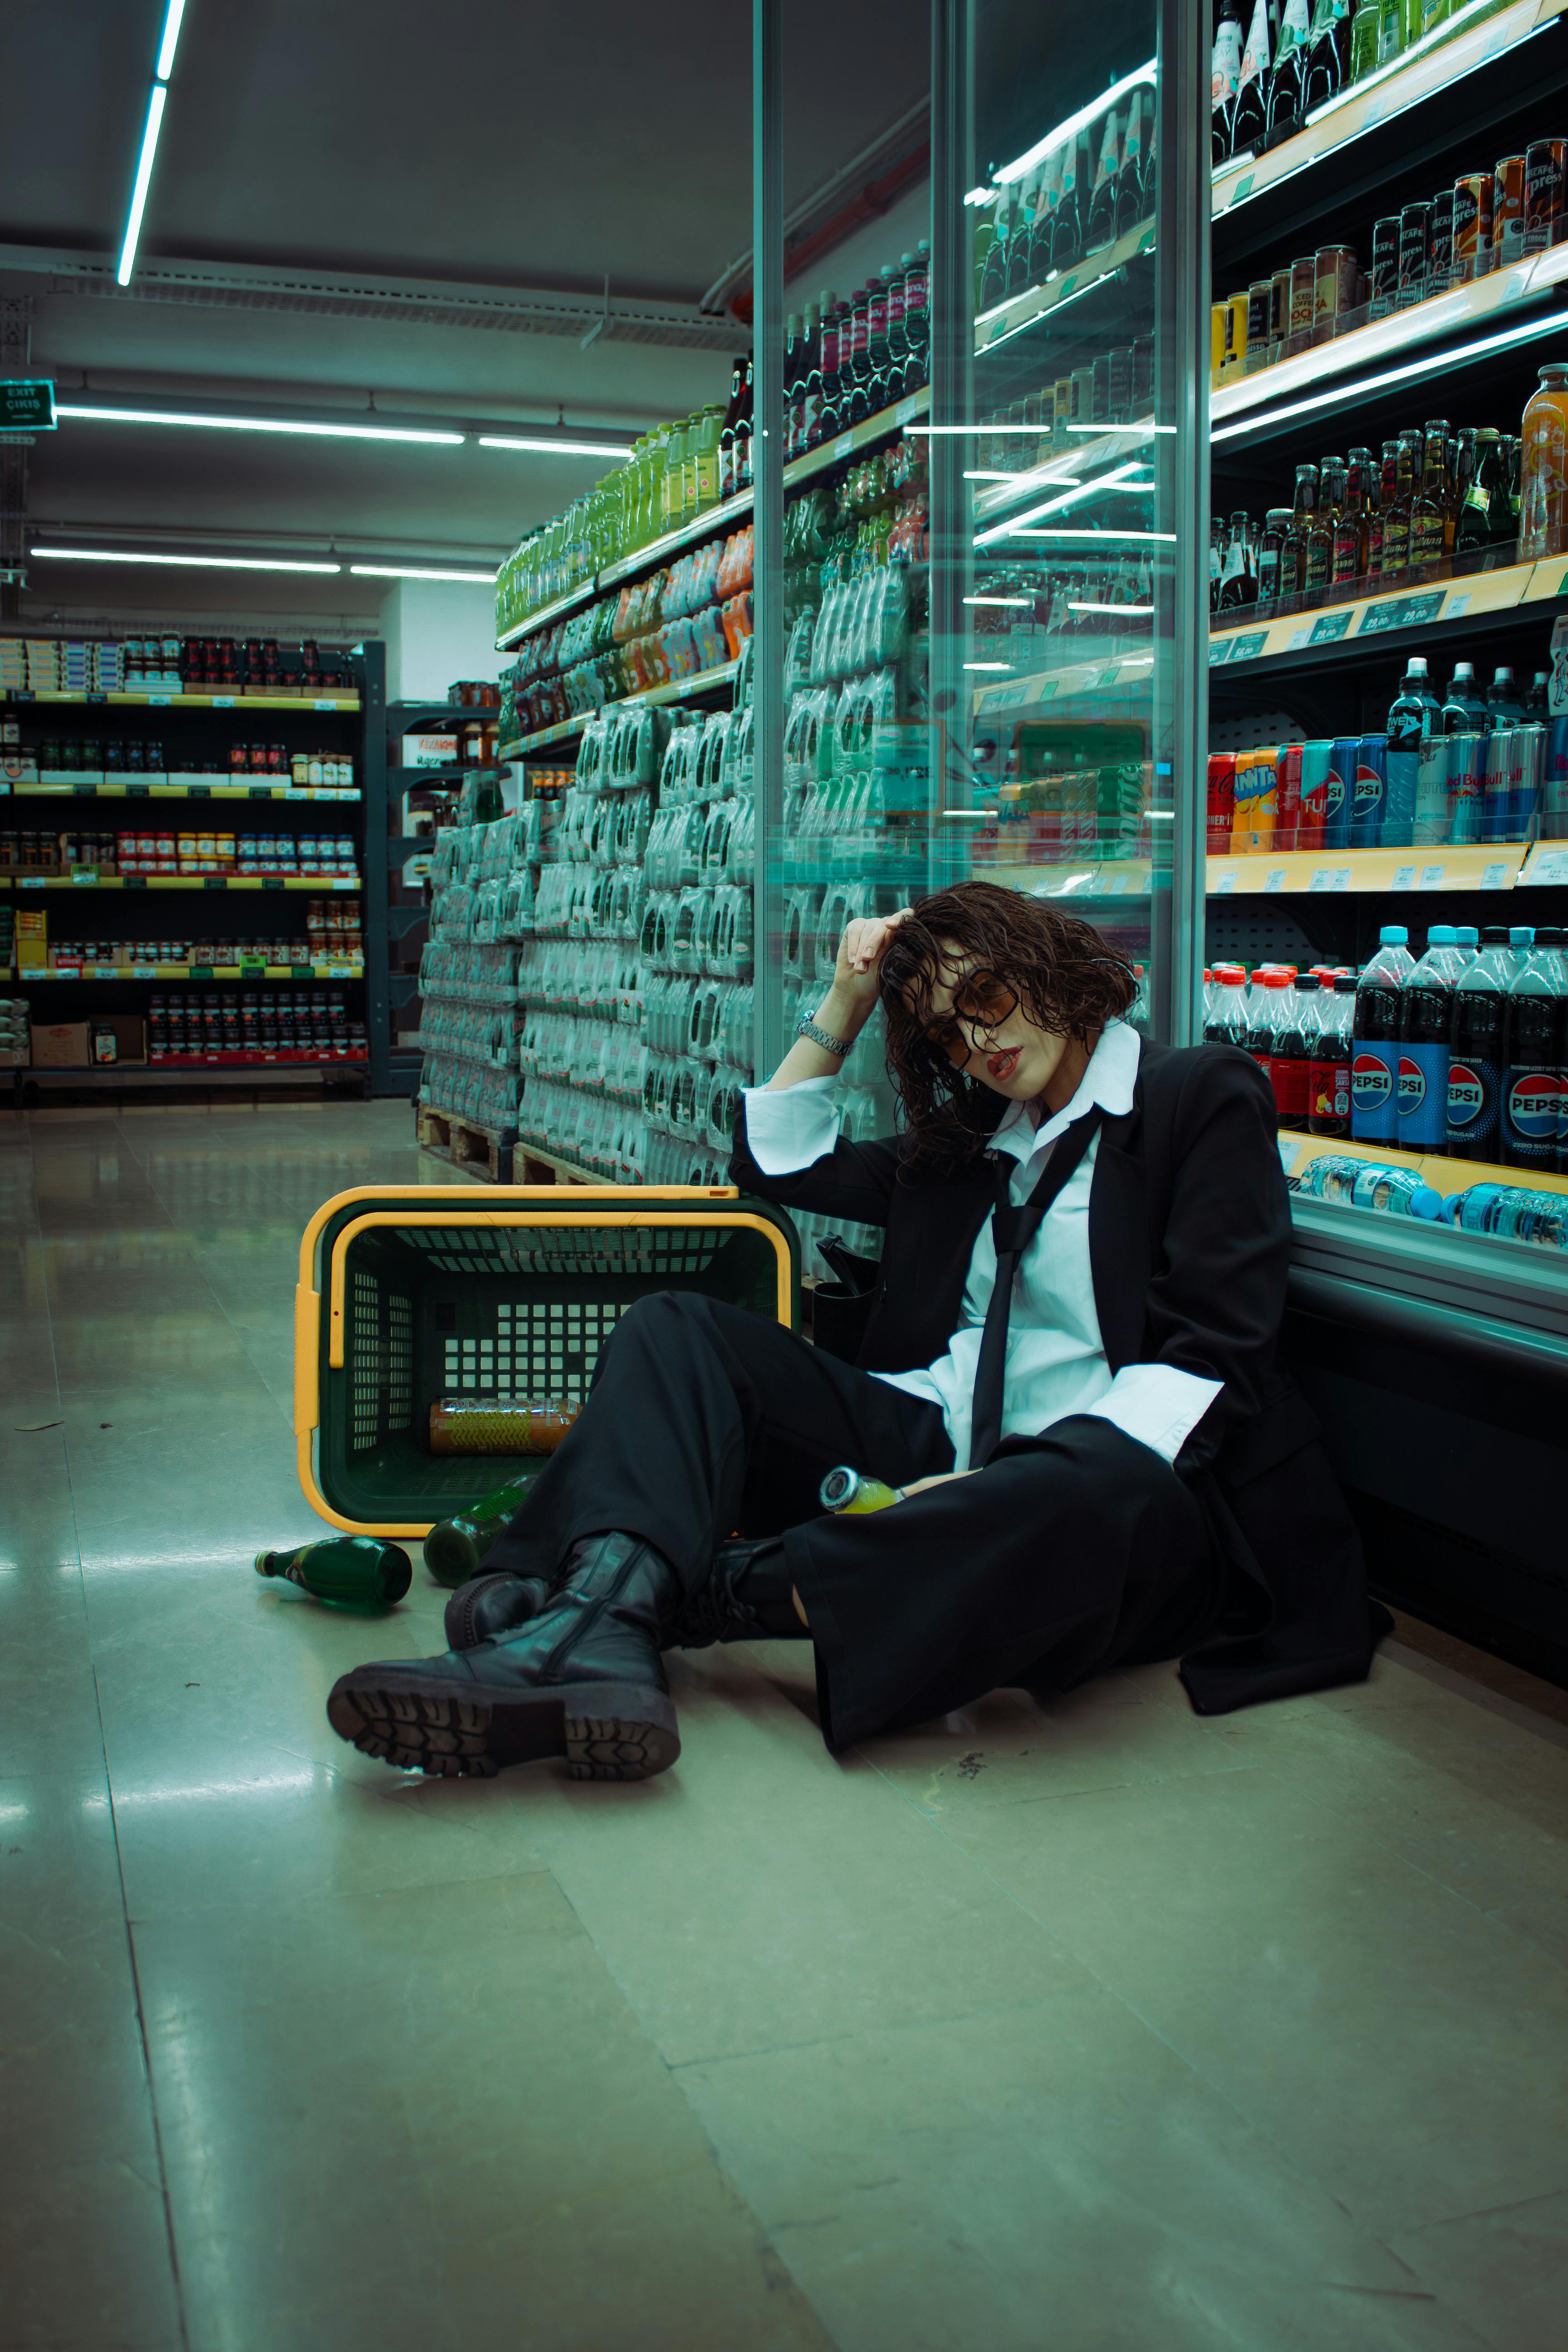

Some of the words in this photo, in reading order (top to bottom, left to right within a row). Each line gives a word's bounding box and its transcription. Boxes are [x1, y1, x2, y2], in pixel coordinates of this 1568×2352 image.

[1530, 172, 1562, 197] press
[1455, 206, 1479, 227] press
[1401, 245, 1423, 260] press
[1374, 258, 1393, 274] press
[1292, 300, 1314, 309] COFFE
[7, 388, 36, 397] EXIT
[1510, 768, 1523, 782] ull
[1449, 1088, 1479, 1102] EPSI
[1512, 1097, 1559, 1113] PEPS
[1453, 1130, 1475, 1138] SUGAR
